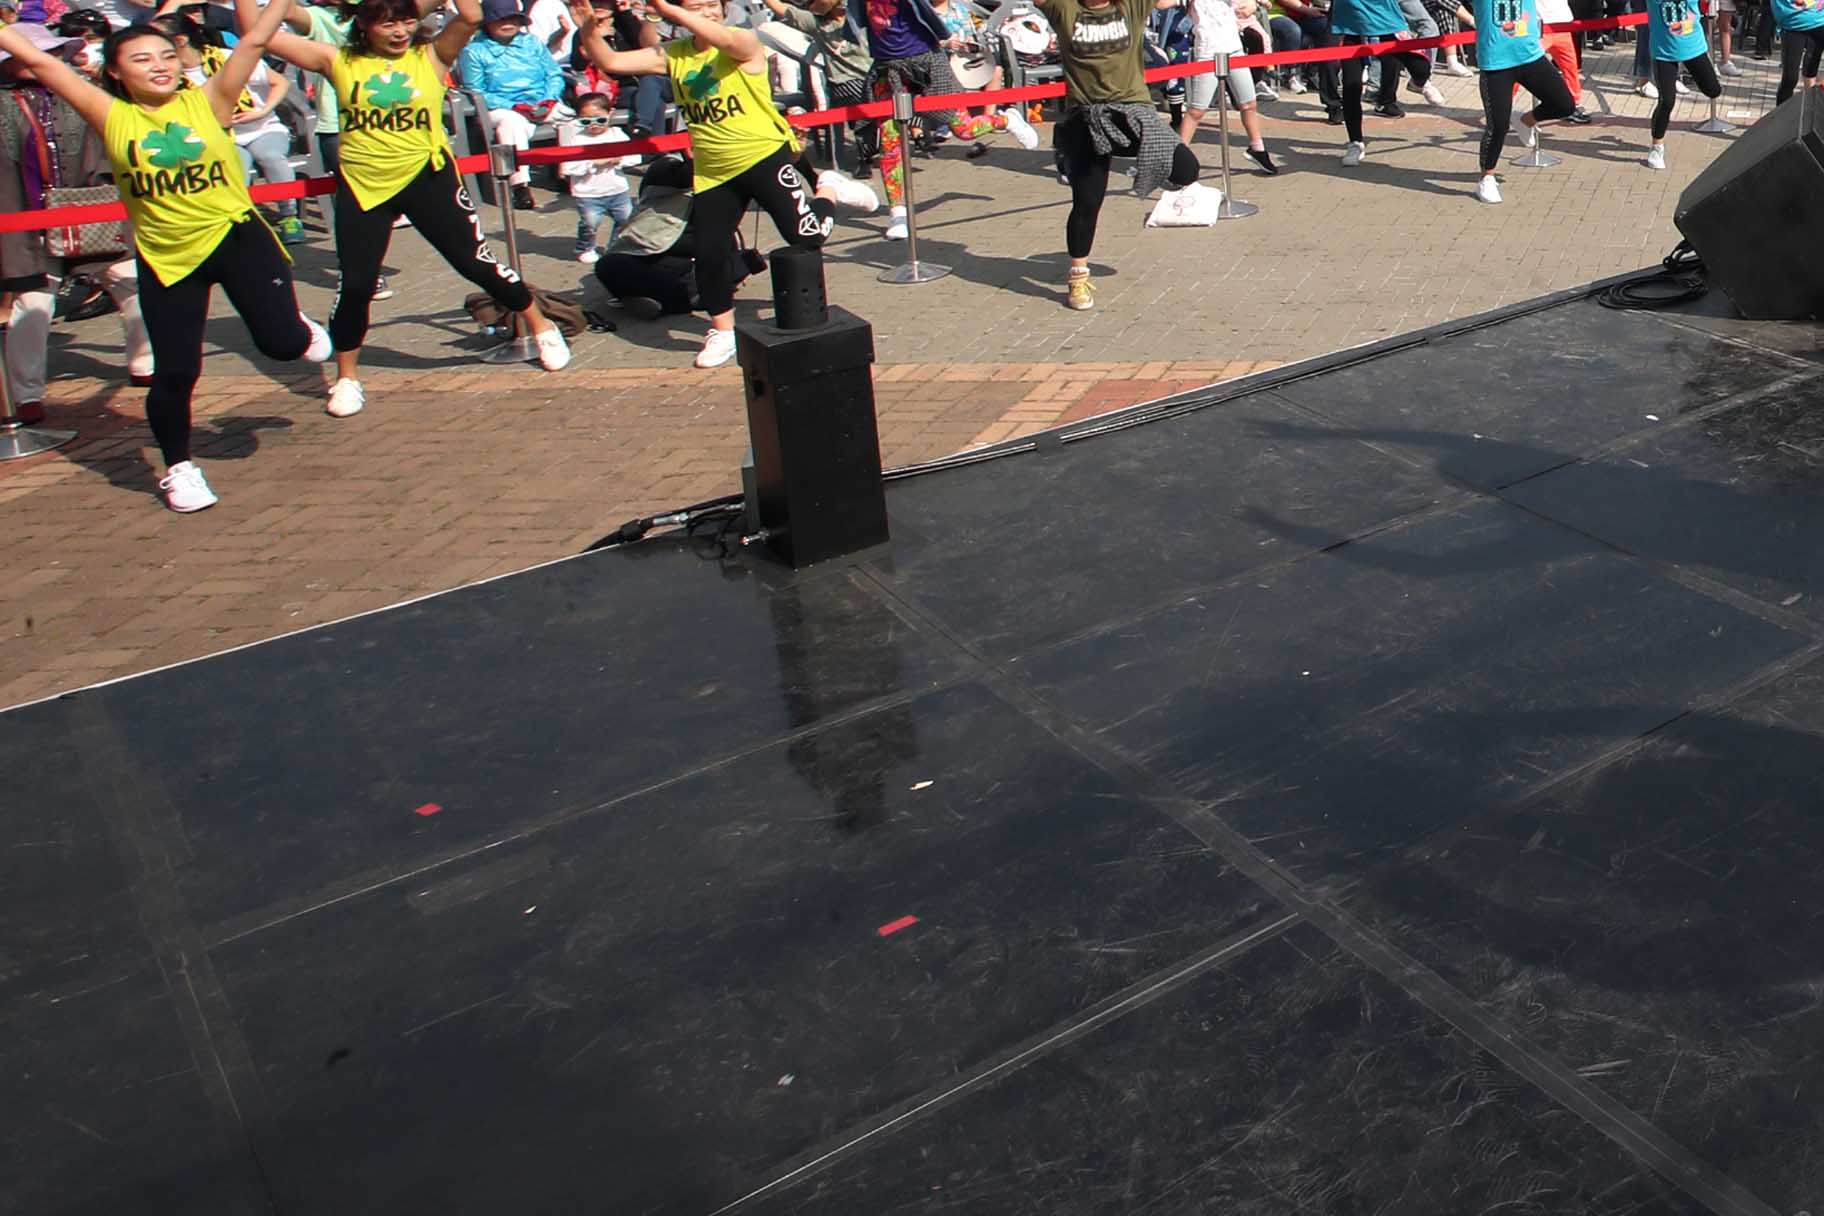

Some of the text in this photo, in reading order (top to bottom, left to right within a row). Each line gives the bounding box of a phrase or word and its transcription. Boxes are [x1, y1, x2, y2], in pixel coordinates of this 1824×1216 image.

[1072, 18, 1129, 43] ZUMBA
[351, 81, 360, 104] I
[339, 106, 433, 132] ZUMBA
[128, 140, 139, 167] I
[121, 160, 229, 198] ZUMBA
